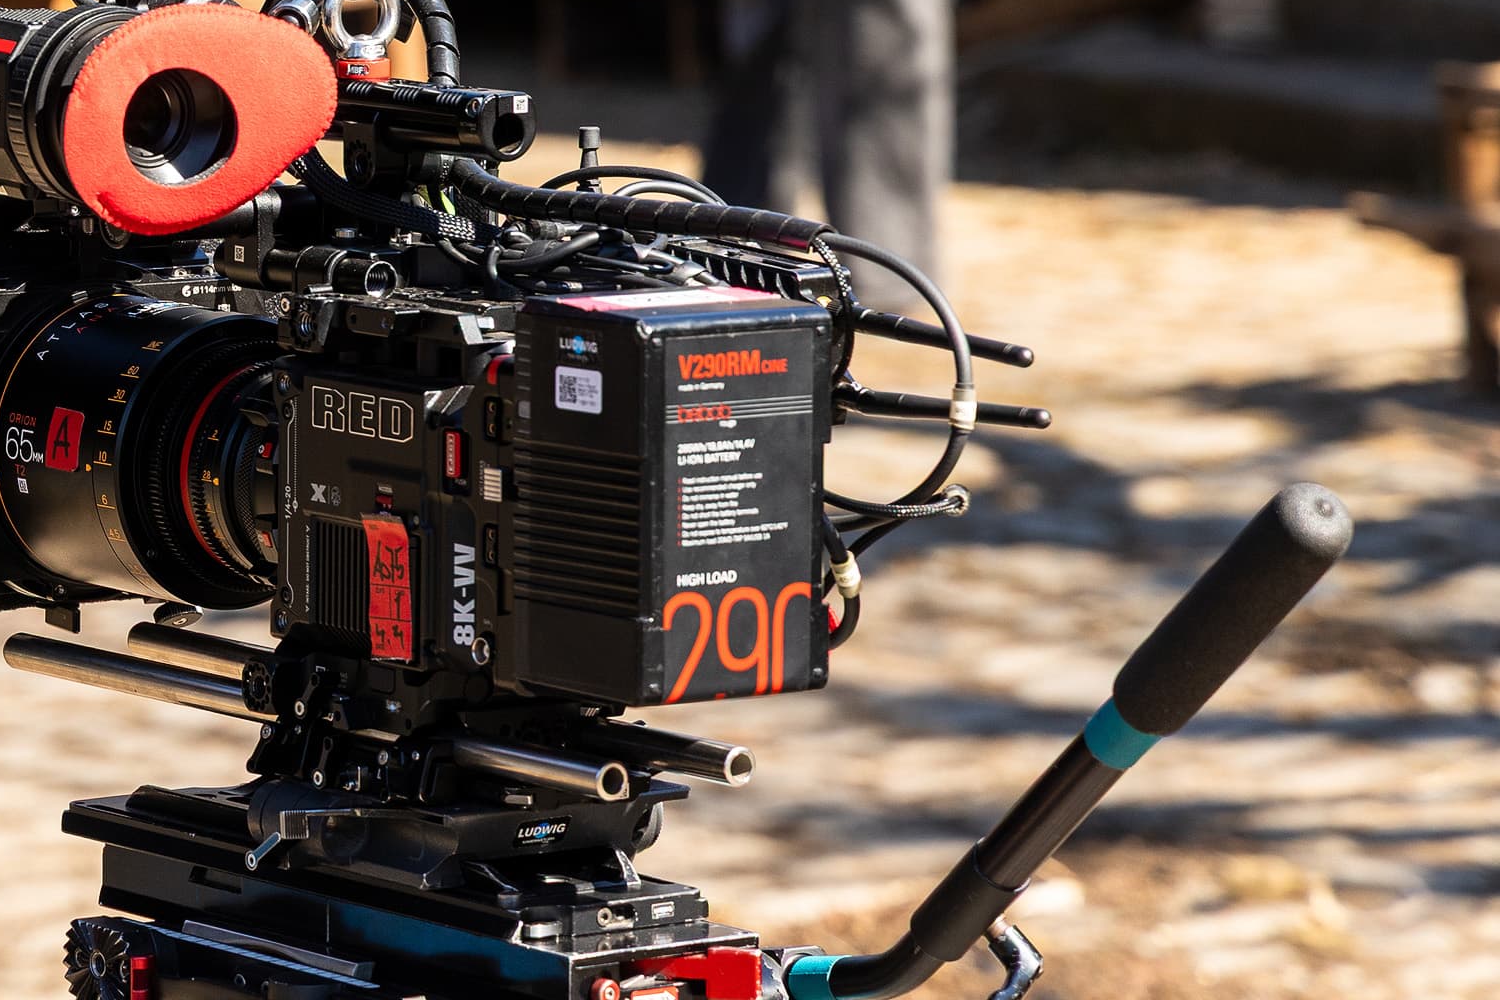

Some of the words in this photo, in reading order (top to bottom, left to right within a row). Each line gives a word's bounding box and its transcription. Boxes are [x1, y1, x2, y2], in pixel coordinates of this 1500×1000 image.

[559, 336, 598, 354] LUDWIG
[127, 365, 140, 375] 60
[677, 349, 761, 381] V290RM
[761, 358, 789, 374] CINE
[113, 388, 126, 400] 30
[9, 412, 37, 427] ORION
[311, 385, 414, 443] RED
[103, 420, 112, 431] 15
[51, 415, 71, 460] A
[98, 450, 107, 462] 10
[14, 463, 26, 477] T2
[101, 494, 108, 505] 6
[310, 482, 327, 504] X
[284, 485, 293, 519] 1/4-20
[676, 573, 705, 588] HIGH
[706, 569, 738, 585] LOAD
[517, 823, 566, 838] LUDWIG
